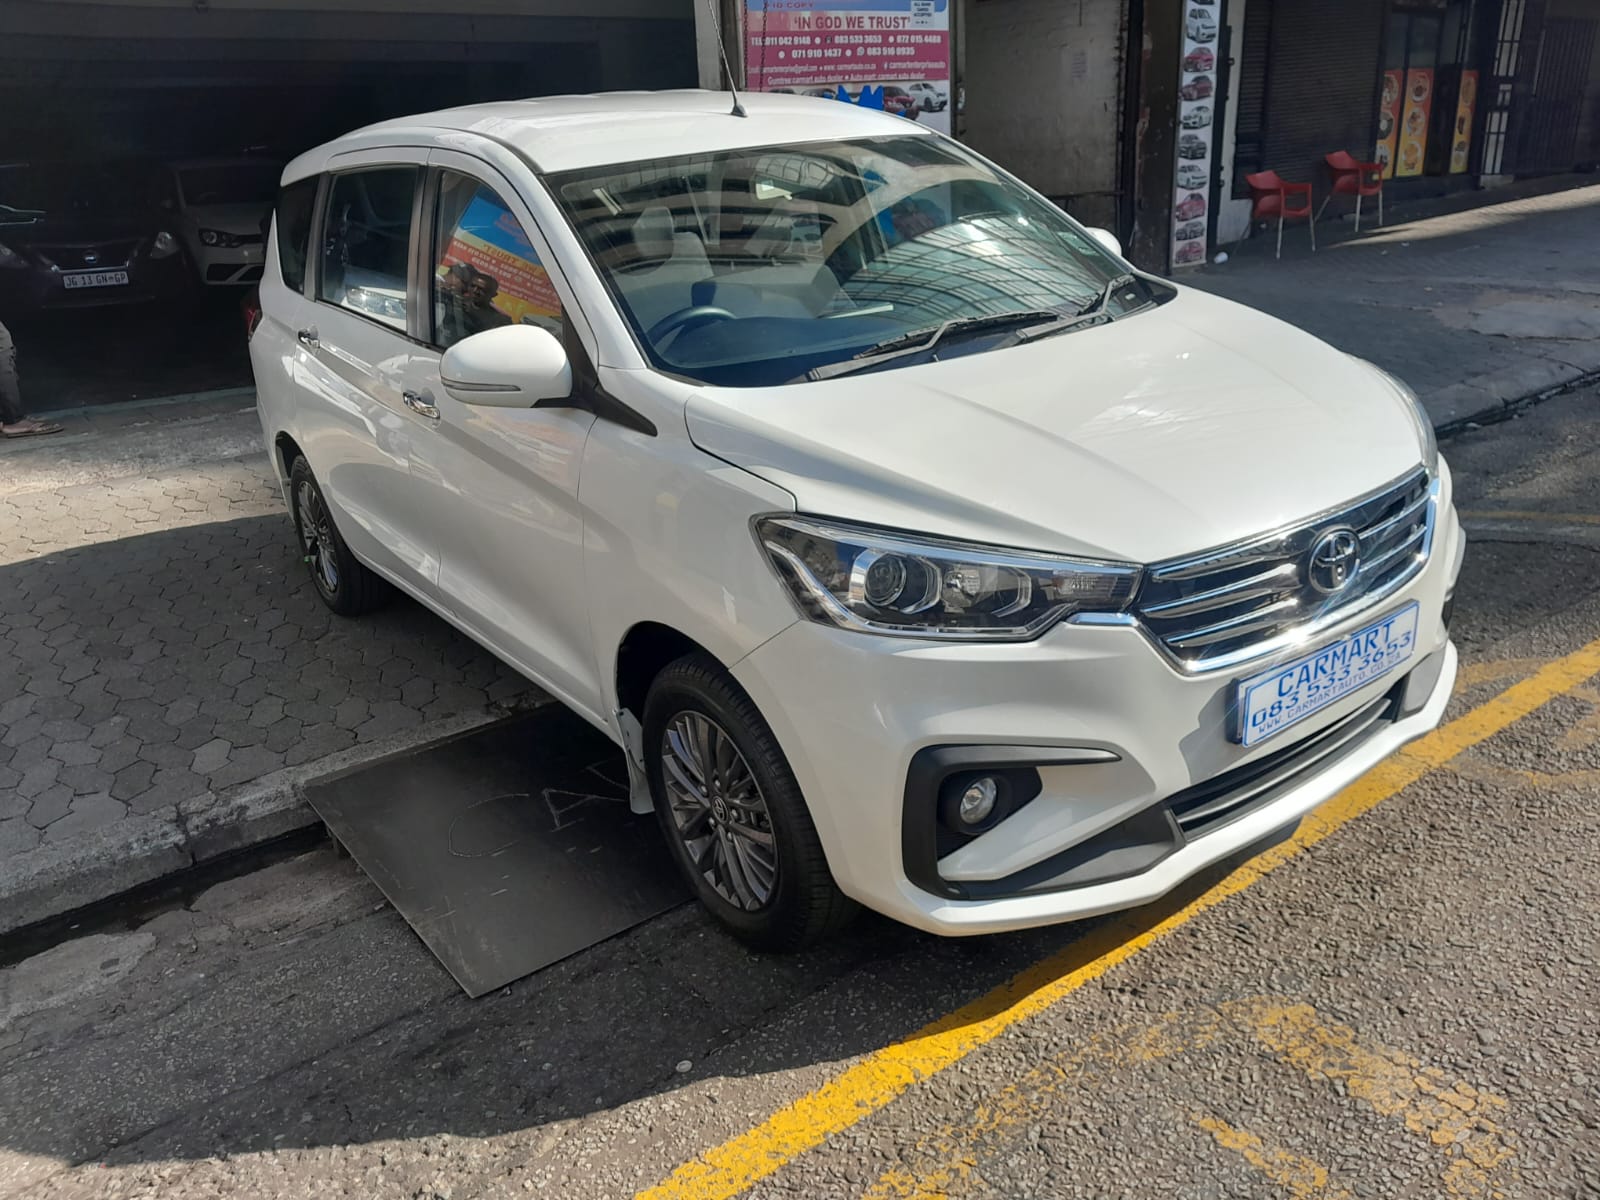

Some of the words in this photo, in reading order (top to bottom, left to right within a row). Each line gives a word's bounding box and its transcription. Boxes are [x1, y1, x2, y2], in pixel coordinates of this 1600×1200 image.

[815, 15, 842, 29] GOD
[846, 15, 864, 29] WE
[66, 277, 78, 287] JG
[82, 275, 93, 285] 13
[96, 274, 108, 284] GN
[114, 273, 126, 283] GP
[1252, 690, 1299, 728] 083
[1307, 663, 1351, 697] 533
[1358, 630, 1411, 671] 3653
[1278, 620, 1396, 697] CARMART
